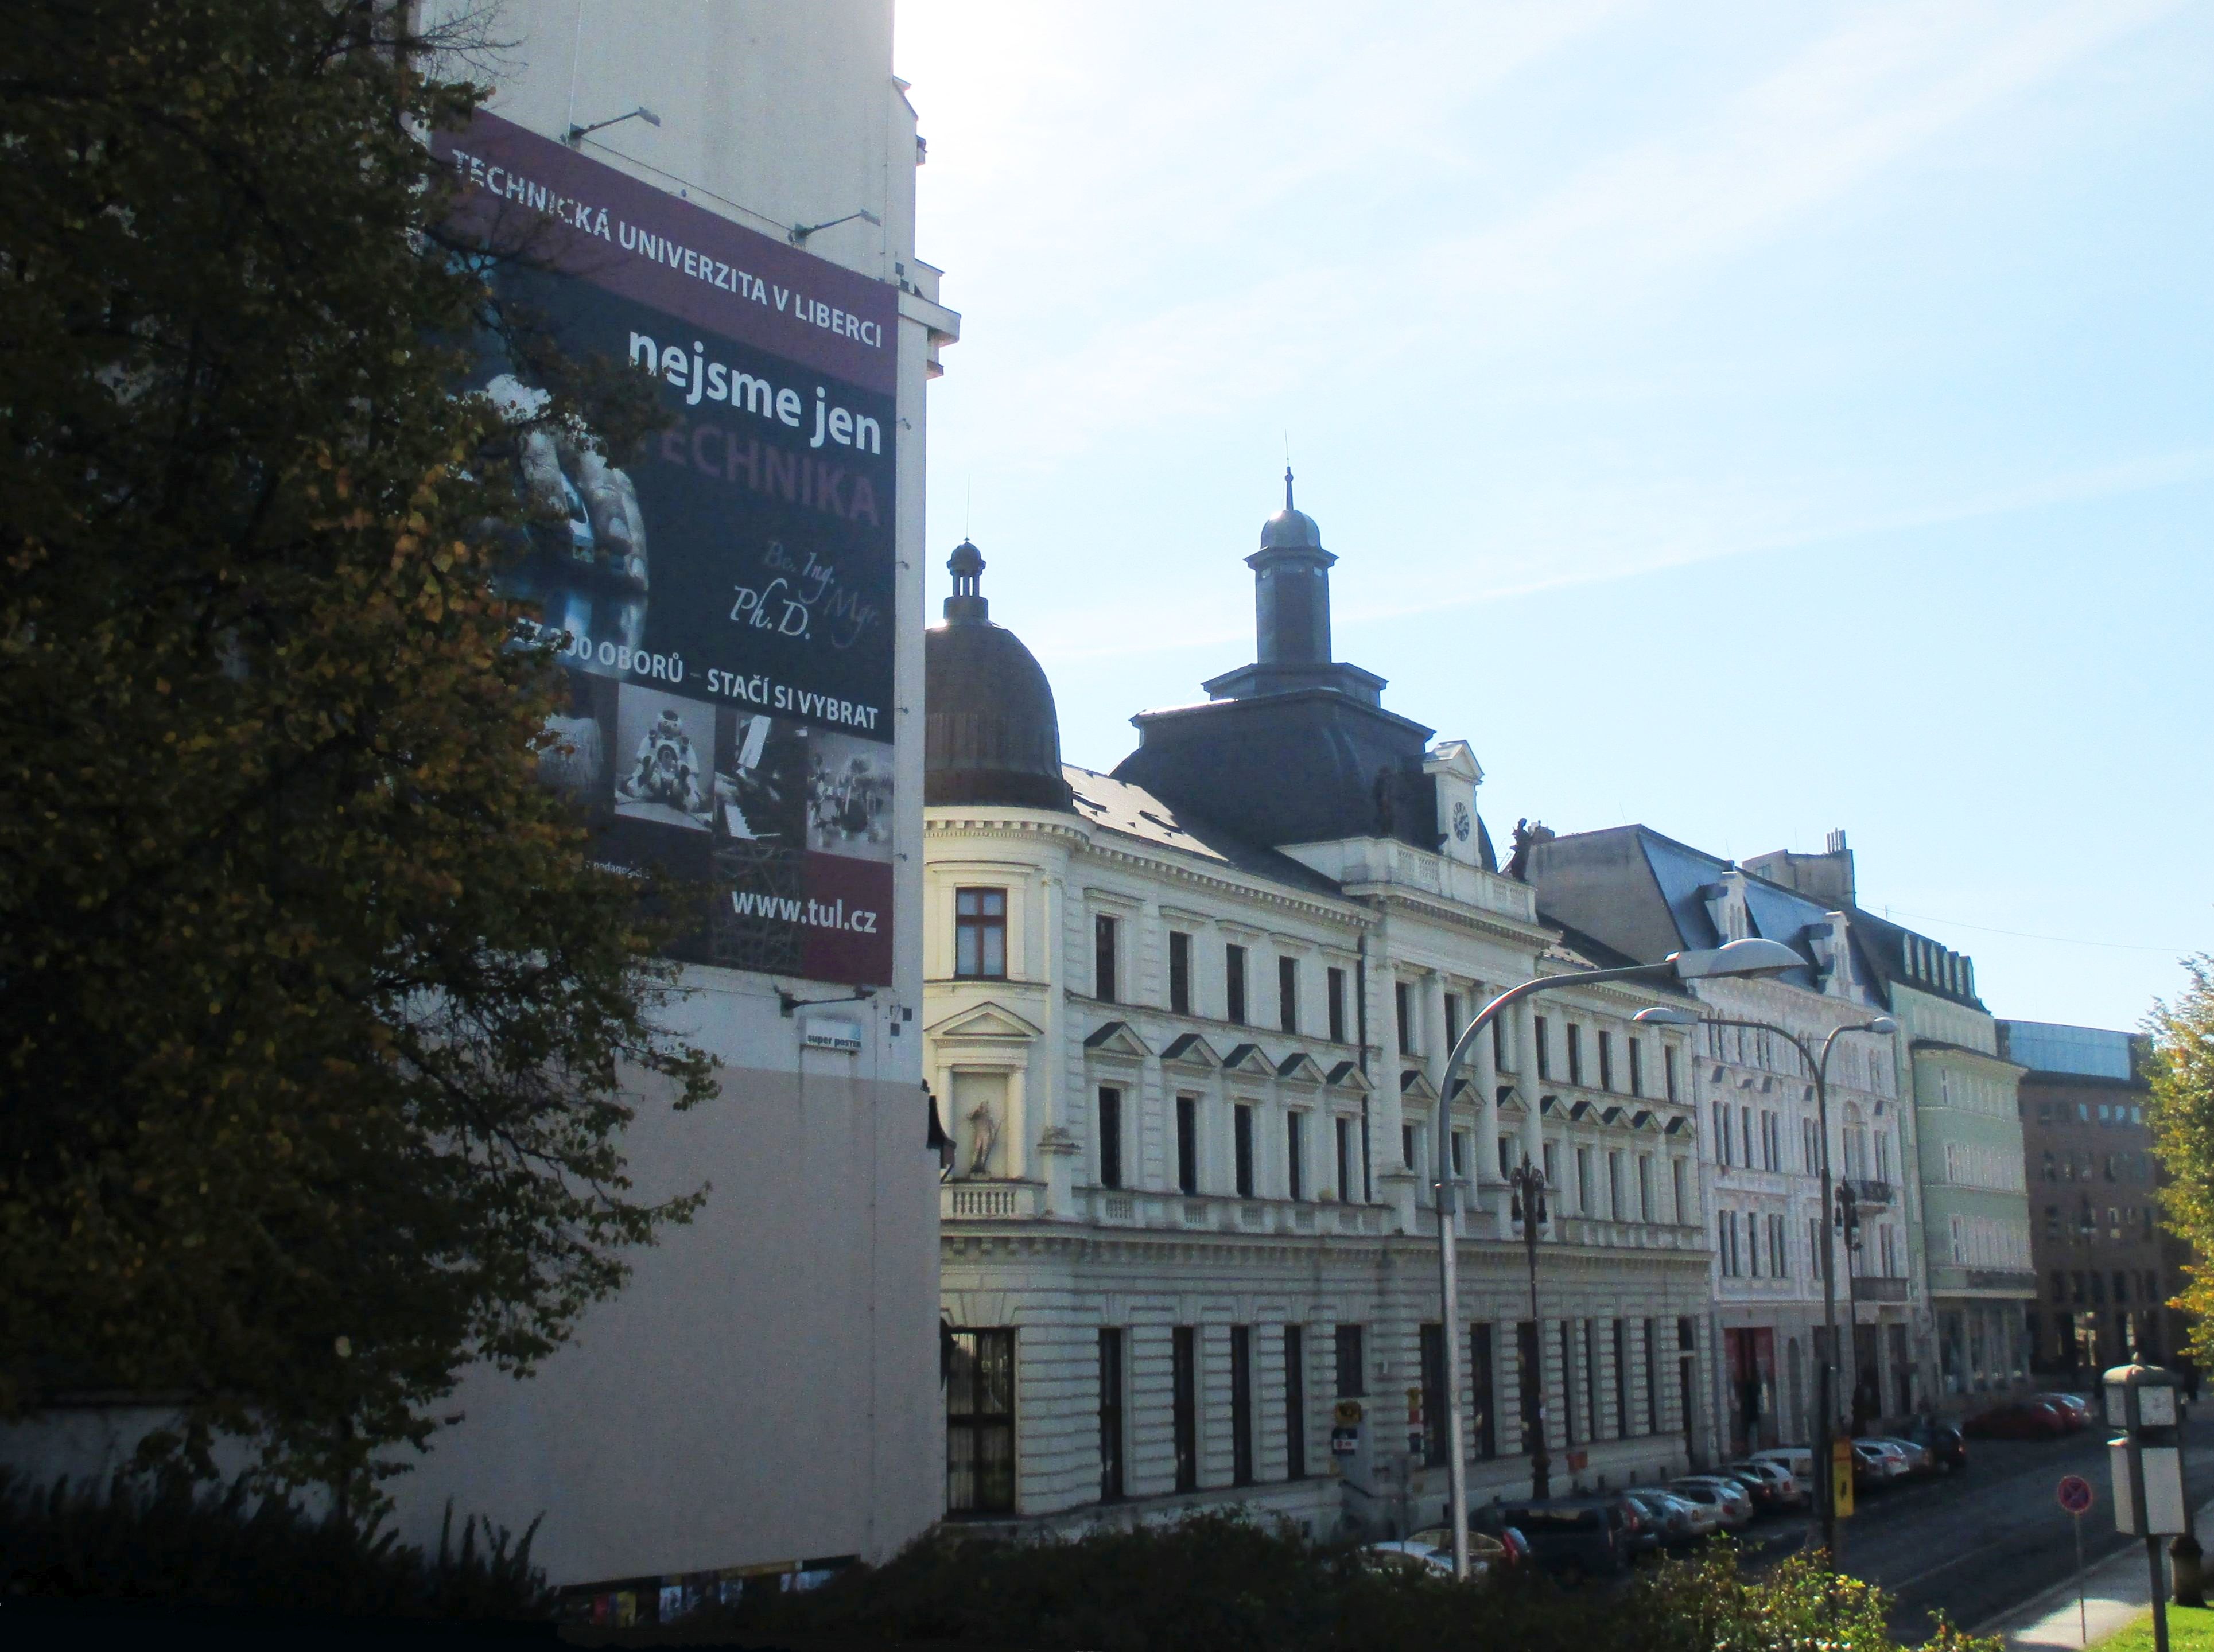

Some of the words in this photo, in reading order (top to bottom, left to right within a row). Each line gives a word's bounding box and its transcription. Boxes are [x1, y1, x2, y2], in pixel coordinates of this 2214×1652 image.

[452, 149, 611, 242] TECHNICKÁ
[619, 220, 767, 306] UNIVERZITA
[772, 285, 789, 312] V
[795, 294, 881, 348] LIBERCI
[629, 331, 802, 428] nejsme
[810, 386, 881, 455] jen
[643, 421, 879, 527] ECHNIKA
[598, 641, 683, 682] OBORŮ
[707, 668, 768, 705] STAČÍ
[774, 685, 793, 712] SI
[798, 689, 879, 730] VYBRAT
[732, 891, 877, 934] www.tul.cz
[807, 1034, 832, 1046] super
